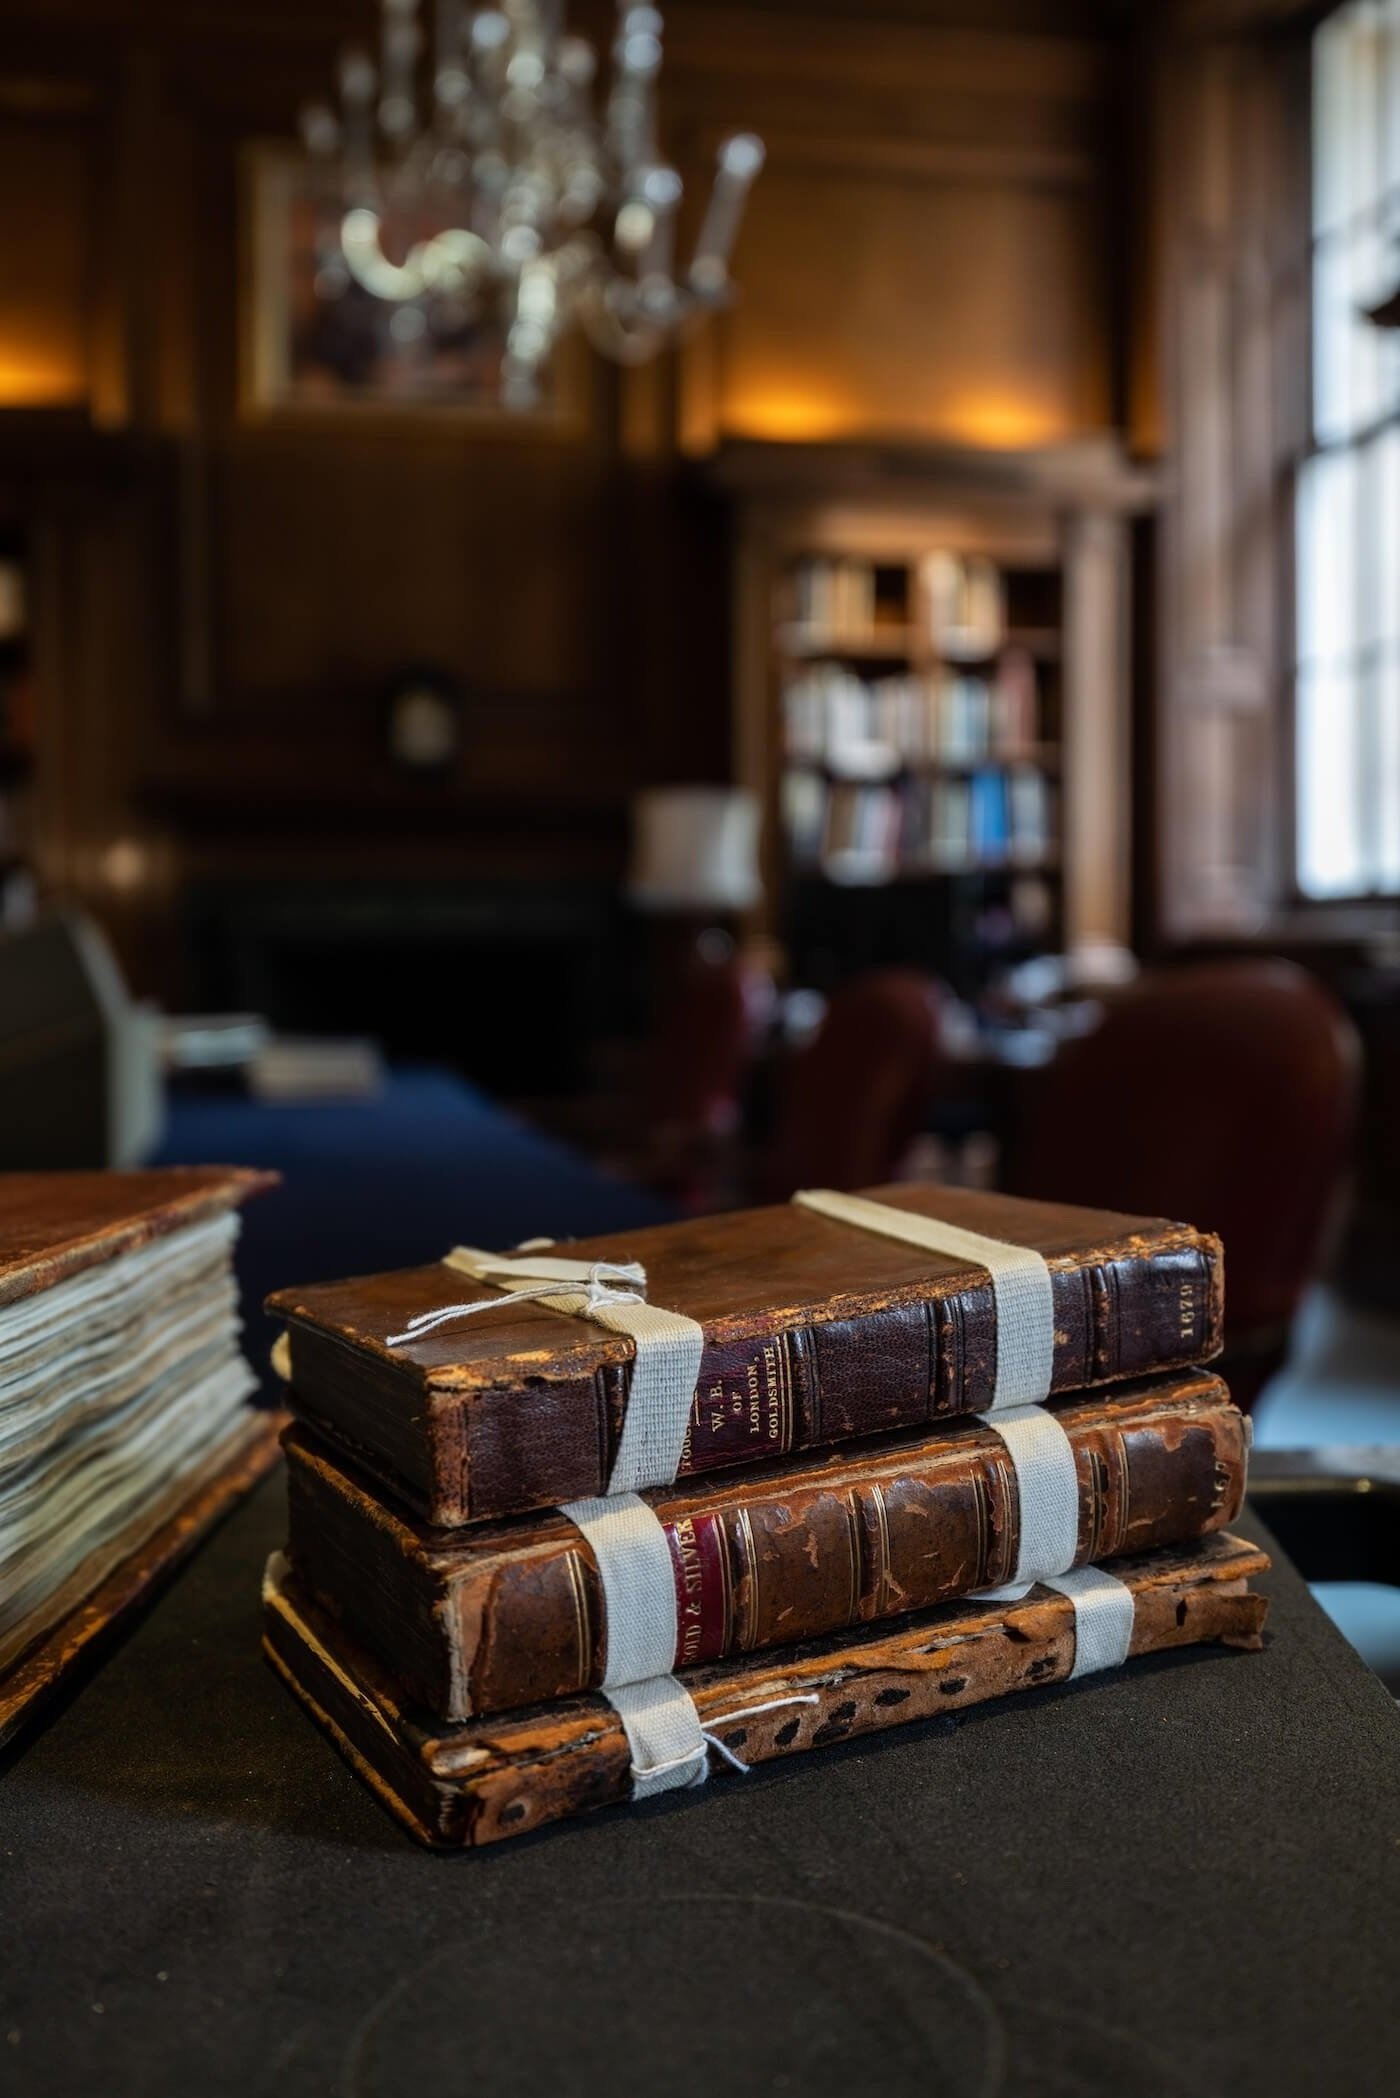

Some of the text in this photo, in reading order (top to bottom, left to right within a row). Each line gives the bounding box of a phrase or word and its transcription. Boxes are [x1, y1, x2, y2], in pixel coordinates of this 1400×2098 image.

[1180, 1284, 1194, 1338] 1679
[710, 1380, 726, 1432] W. B.
[732, 1391, 743, 1412] OF
[747, 1356, 761, 1434] LONDON,
[764, 1346, 778, 1439] GOLDSMITH
[677, 1518, 702, 1594] SILVER
[686, 1600, 702, 1616] &
